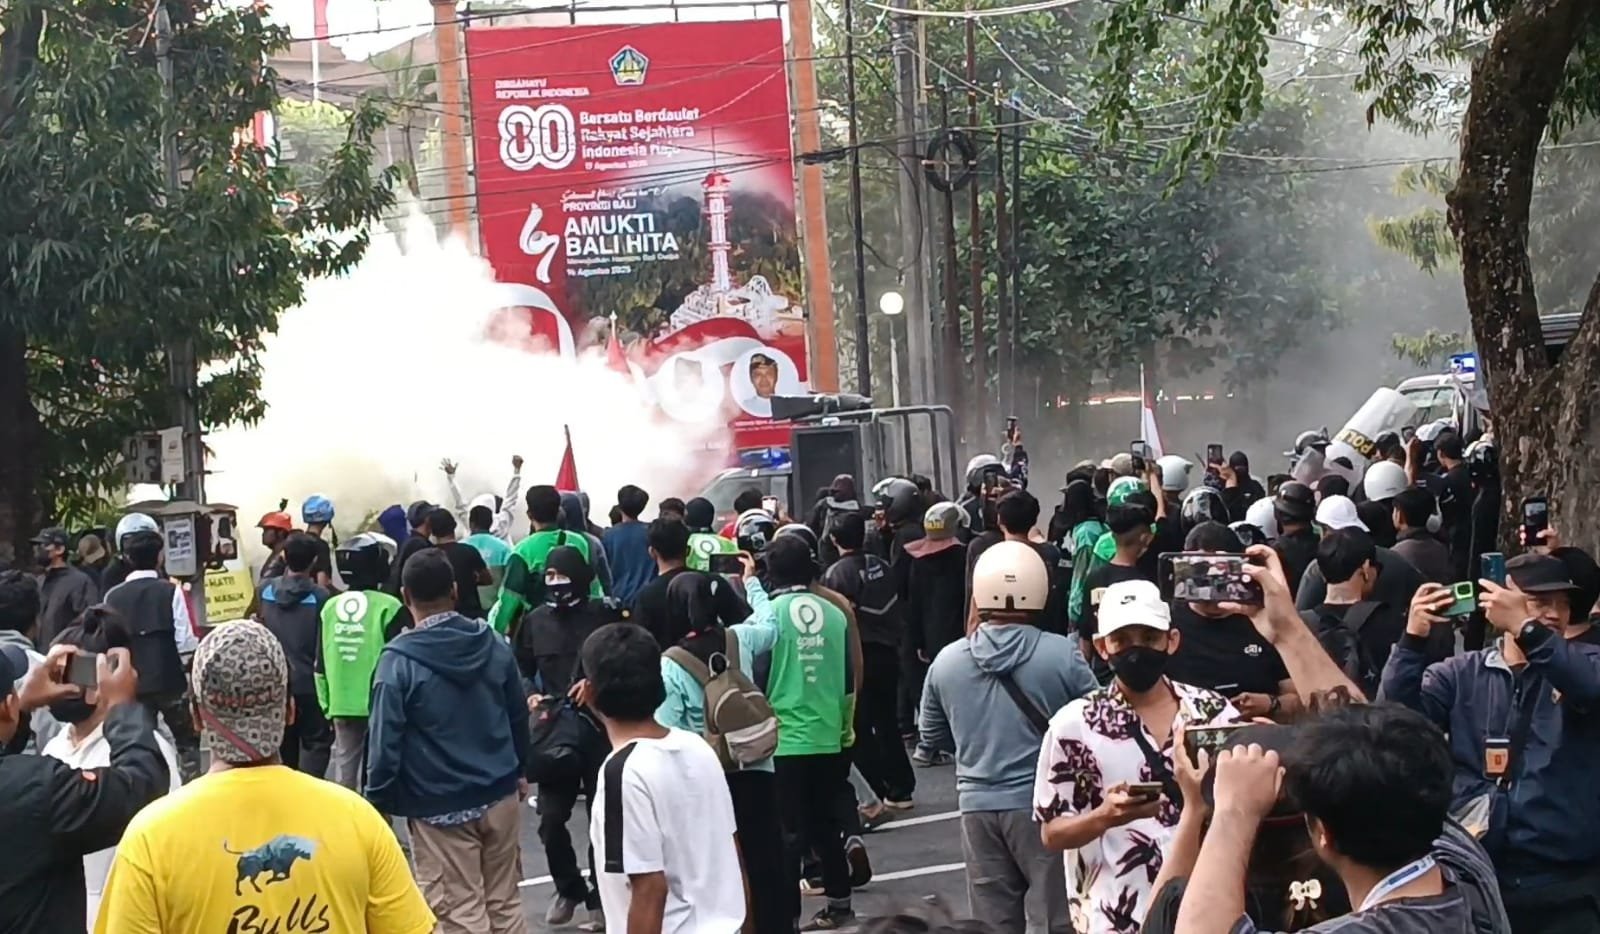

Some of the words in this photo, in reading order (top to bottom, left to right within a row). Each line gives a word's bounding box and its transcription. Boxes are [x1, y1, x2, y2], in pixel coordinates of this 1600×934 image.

[580, 111, 632, 125] Bersatu
[634, 107, 700, 123] Berdaulat
[498, 104, 576, 171] 80
[630, 125, 695, 142] Sejahtera
[582, 142, 647, 159] Indonesia
[612, 199, 637, 210] BALI
[564, 213, 655, 236] AMUKTI
[566, 236, 620, 257] BALI
[626, 232, 679, 253] HITA
[227, 894, 330, 934] Bulls
